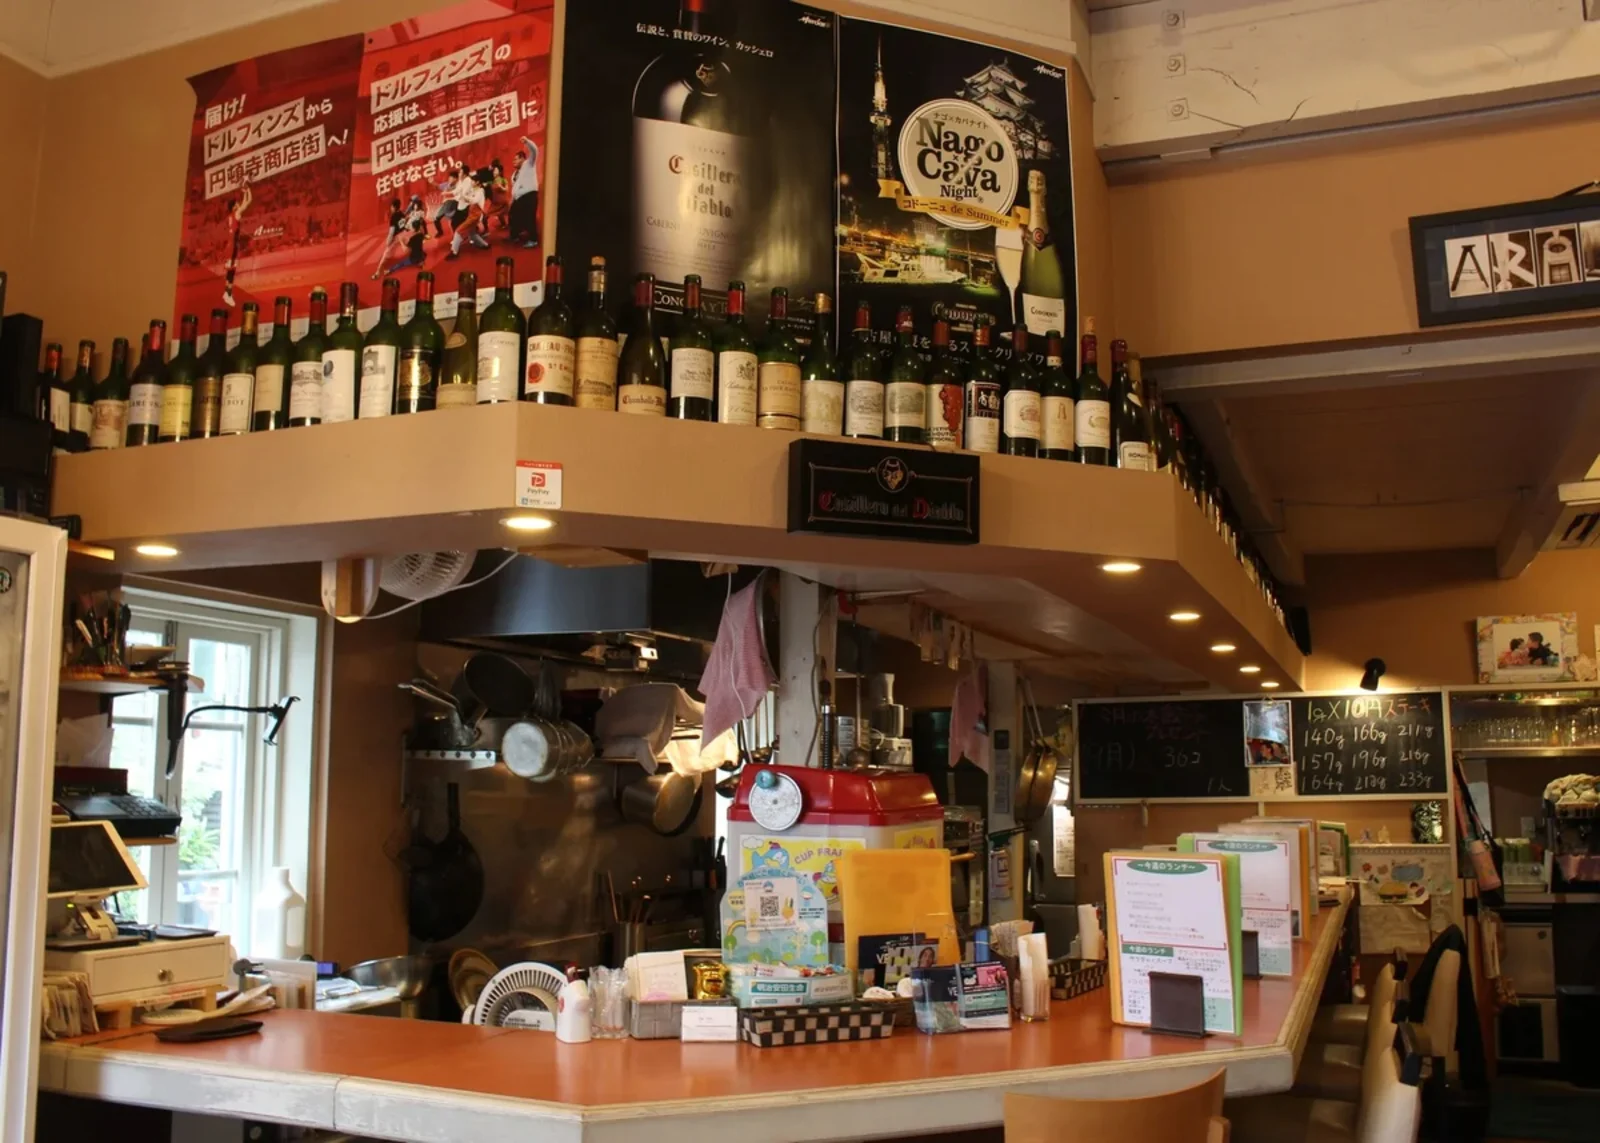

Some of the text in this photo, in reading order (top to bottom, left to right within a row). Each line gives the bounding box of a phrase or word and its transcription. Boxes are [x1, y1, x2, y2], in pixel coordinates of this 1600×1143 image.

[375, 44, 512, 107] ドルフィンズの
[207, 99, 333, 158] ドルフィンズから
[373, 102, 427, 135] 応援は、
[376, 100, 539, 167] 円頓寺商店街に
[916, 117, 1005, 166] Nago
[375, 156, 463, 196] 任せなさい。
[917, 148, 1001, 193] Cava
[697, 182, 715, 196] del
[940, 185, 978, 201] Night
[903, 198, 1010, 227] コドーニュ de Summer
[1304, 728, 1345, 750] 140g
[1353, 723, 1388, 744] 166g
[1301, 752, 1344, 774] 157g
[1352, 750, 1388, 770] 196g
[1301, 774, 1345, 792] 164g
[1399, 770, 1433, 788] 233g
[795, 850, 814, 865] CUP
